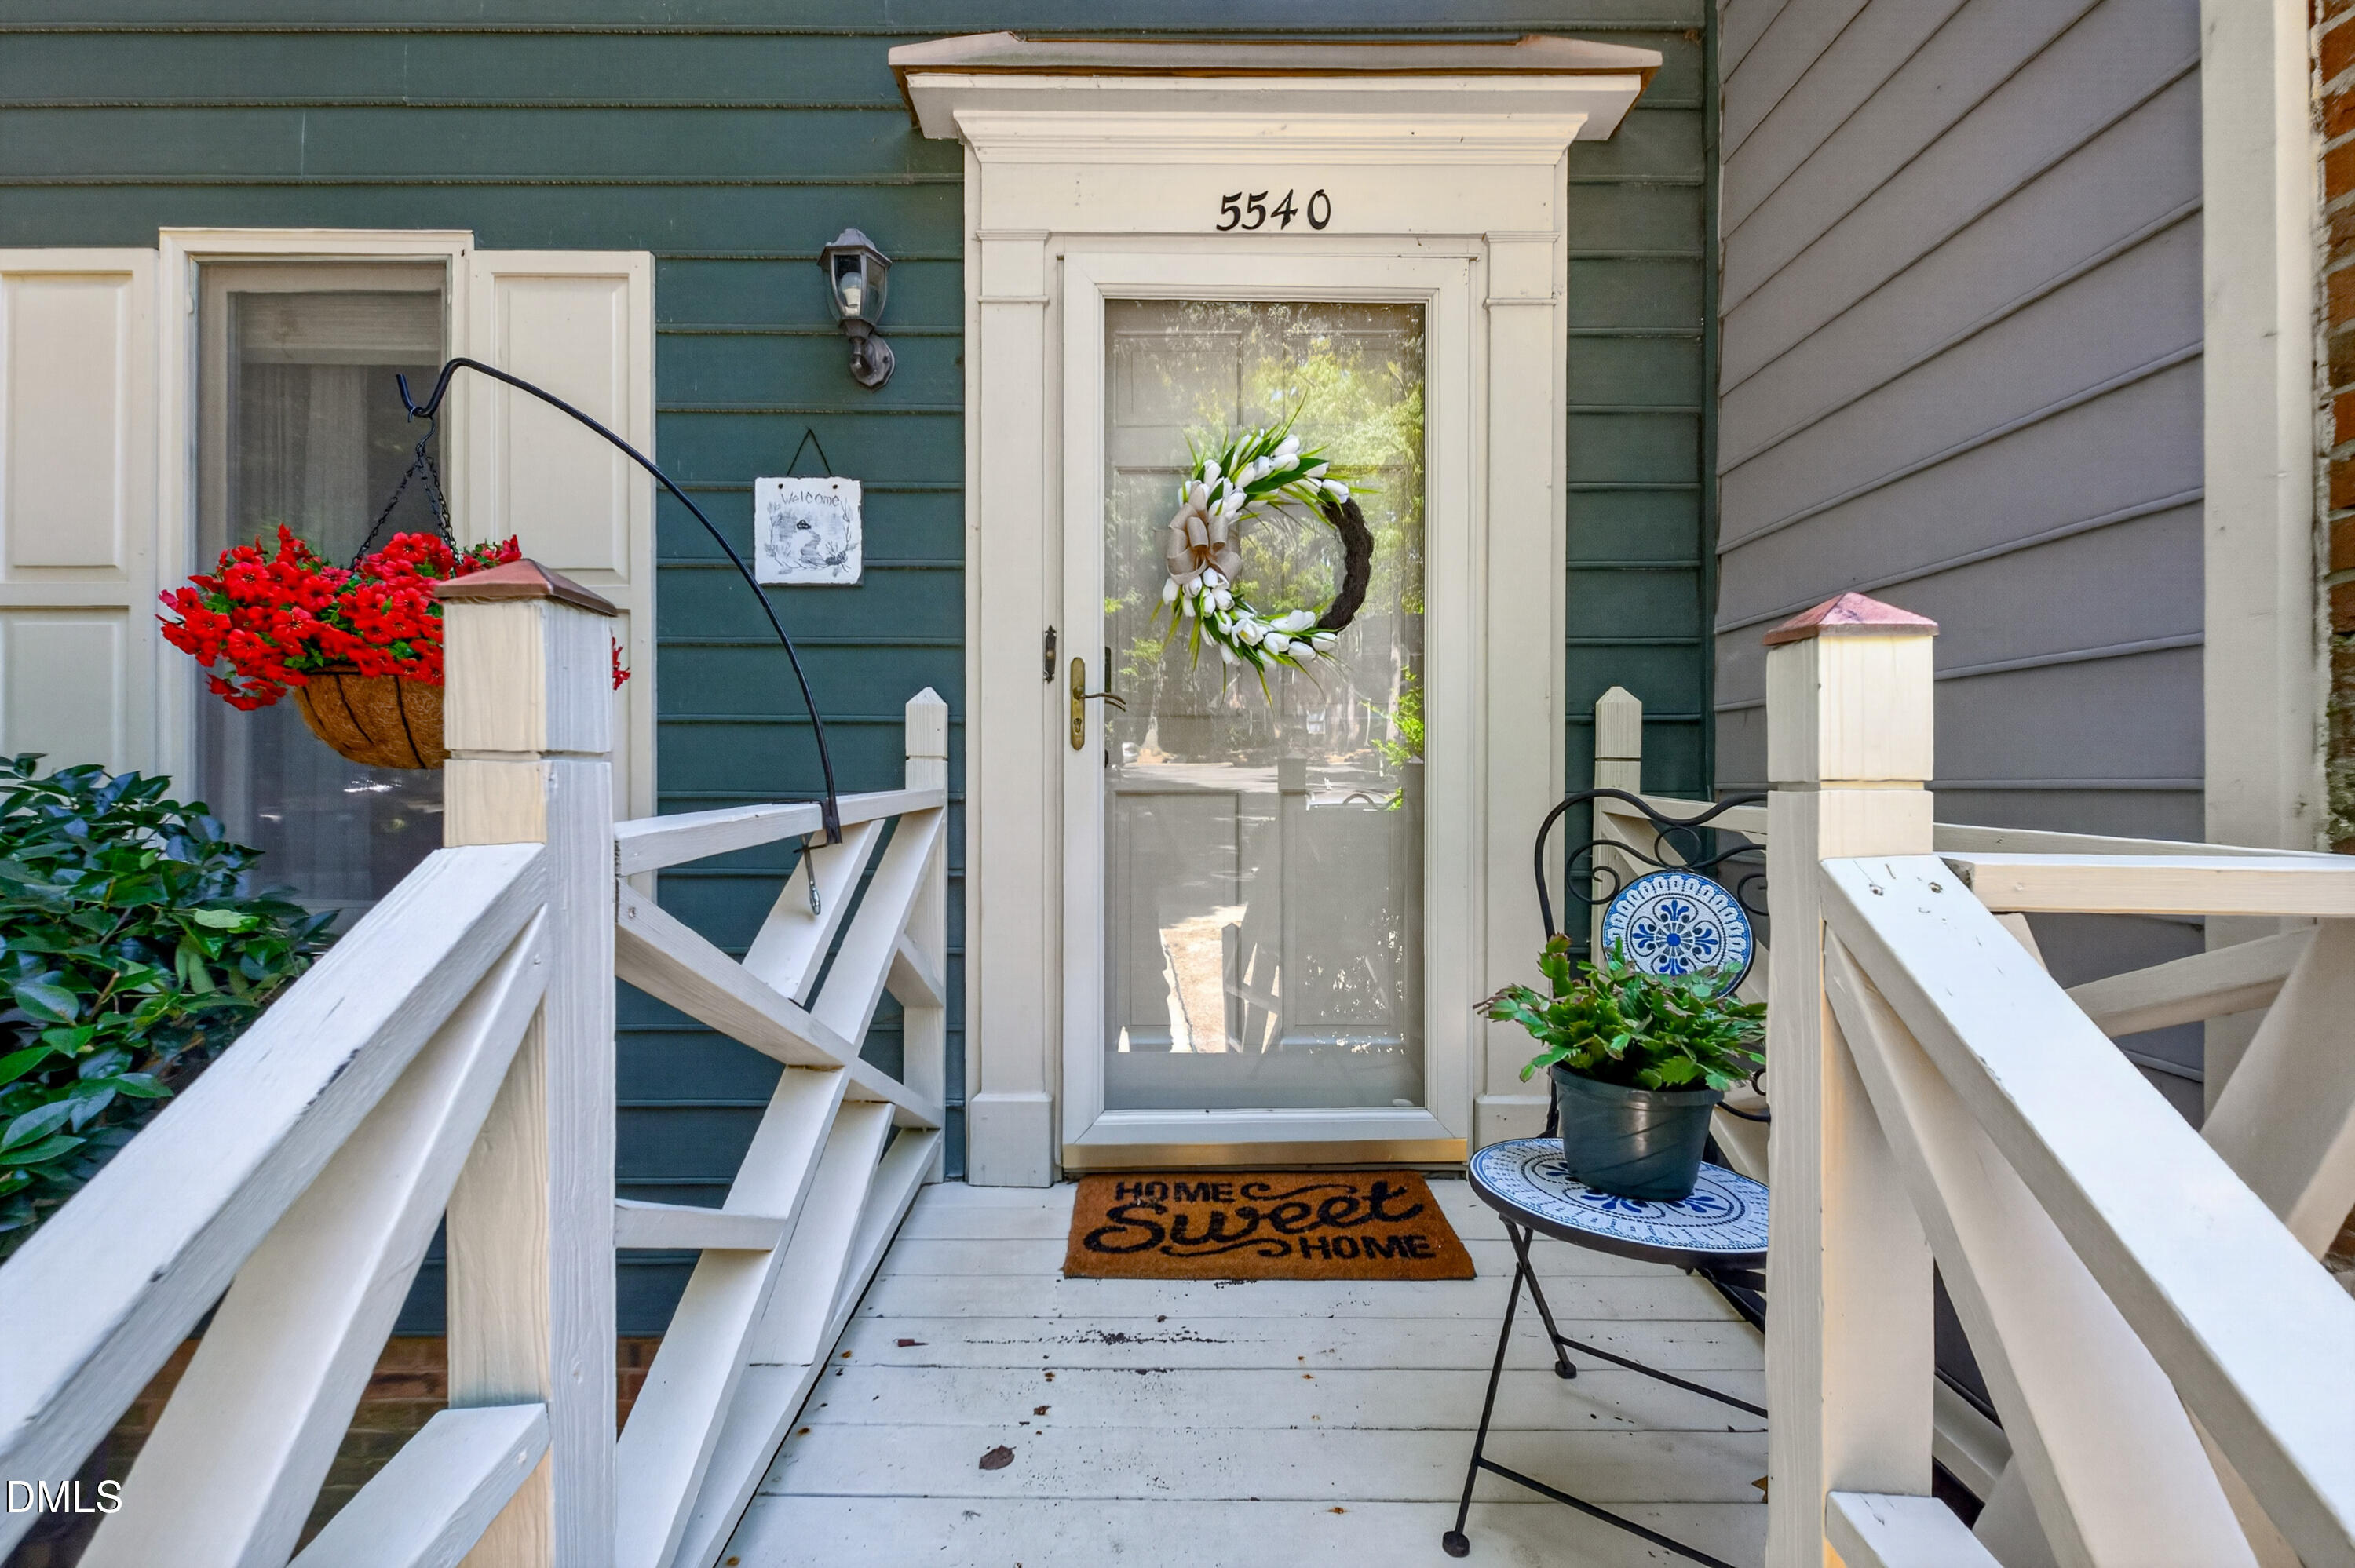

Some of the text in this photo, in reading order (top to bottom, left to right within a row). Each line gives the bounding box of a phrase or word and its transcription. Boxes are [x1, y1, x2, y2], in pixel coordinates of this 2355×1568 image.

[1216, 188, 1331, 231] 5540
[781, 490, 840, 507] Welcome
[1115, 1181, 1235, 1202] HOME
[1083, 1180, 1424, 1256] Sweet
[1299, 1234, 1436, 1260] HOME
